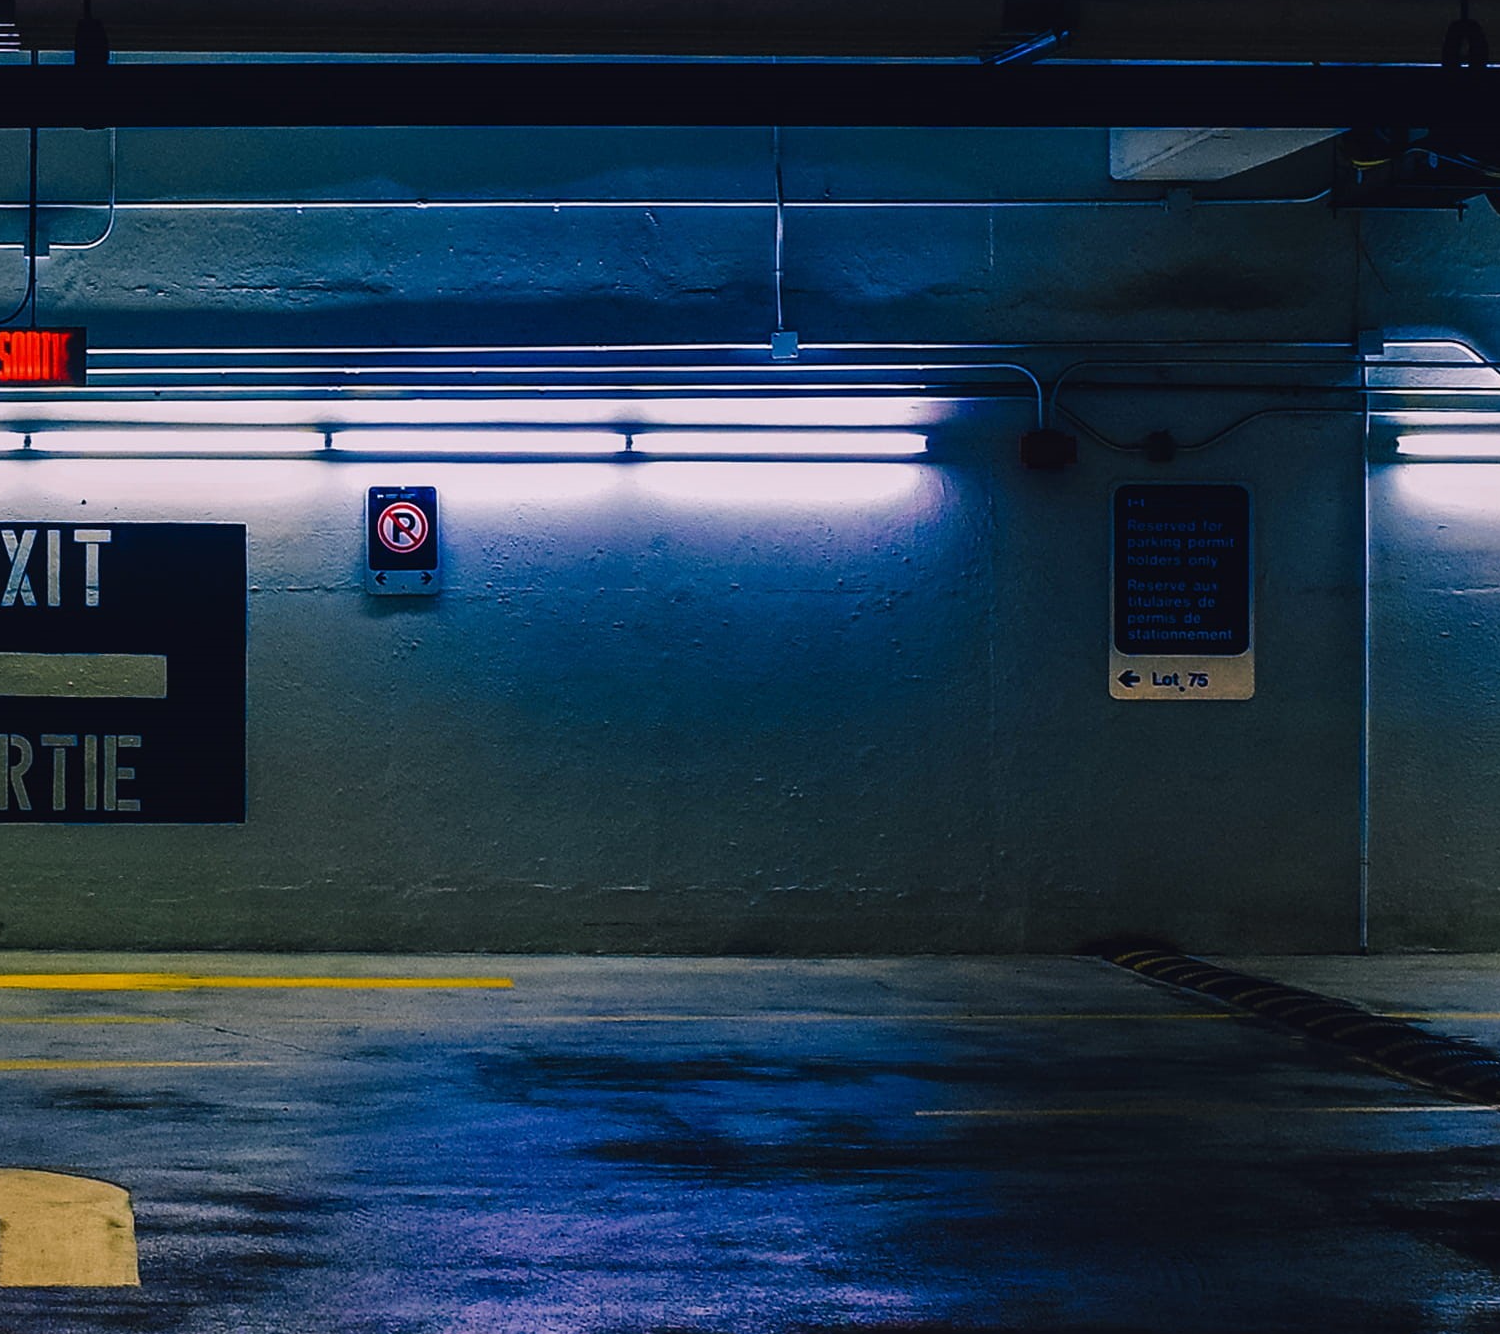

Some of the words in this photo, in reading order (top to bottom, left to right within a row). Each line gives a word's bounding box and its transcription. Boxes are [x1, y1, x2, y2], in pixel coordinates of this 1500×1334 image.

[1127, 519, 1196, 532] Reserved
[1202, 519, 1224, 532] for
[1127, 535, 1181, 550] parking
[1188, 536, 1236, 550] permit
[1127, 553, 1181, 566] holders
[1188, 553, 1219, 569] only
[1127, 594, 1192, 608] titulaires
[1197, 594, 1216, 608] de
[1127, 611, 1177, 625] permis
[1183, 610, 1201, 624] de
[1127, 627, 1233, 640] stationnement
[1151, 671, 1179, 686] Lot
[1187, 672, 1209, 687] 75
